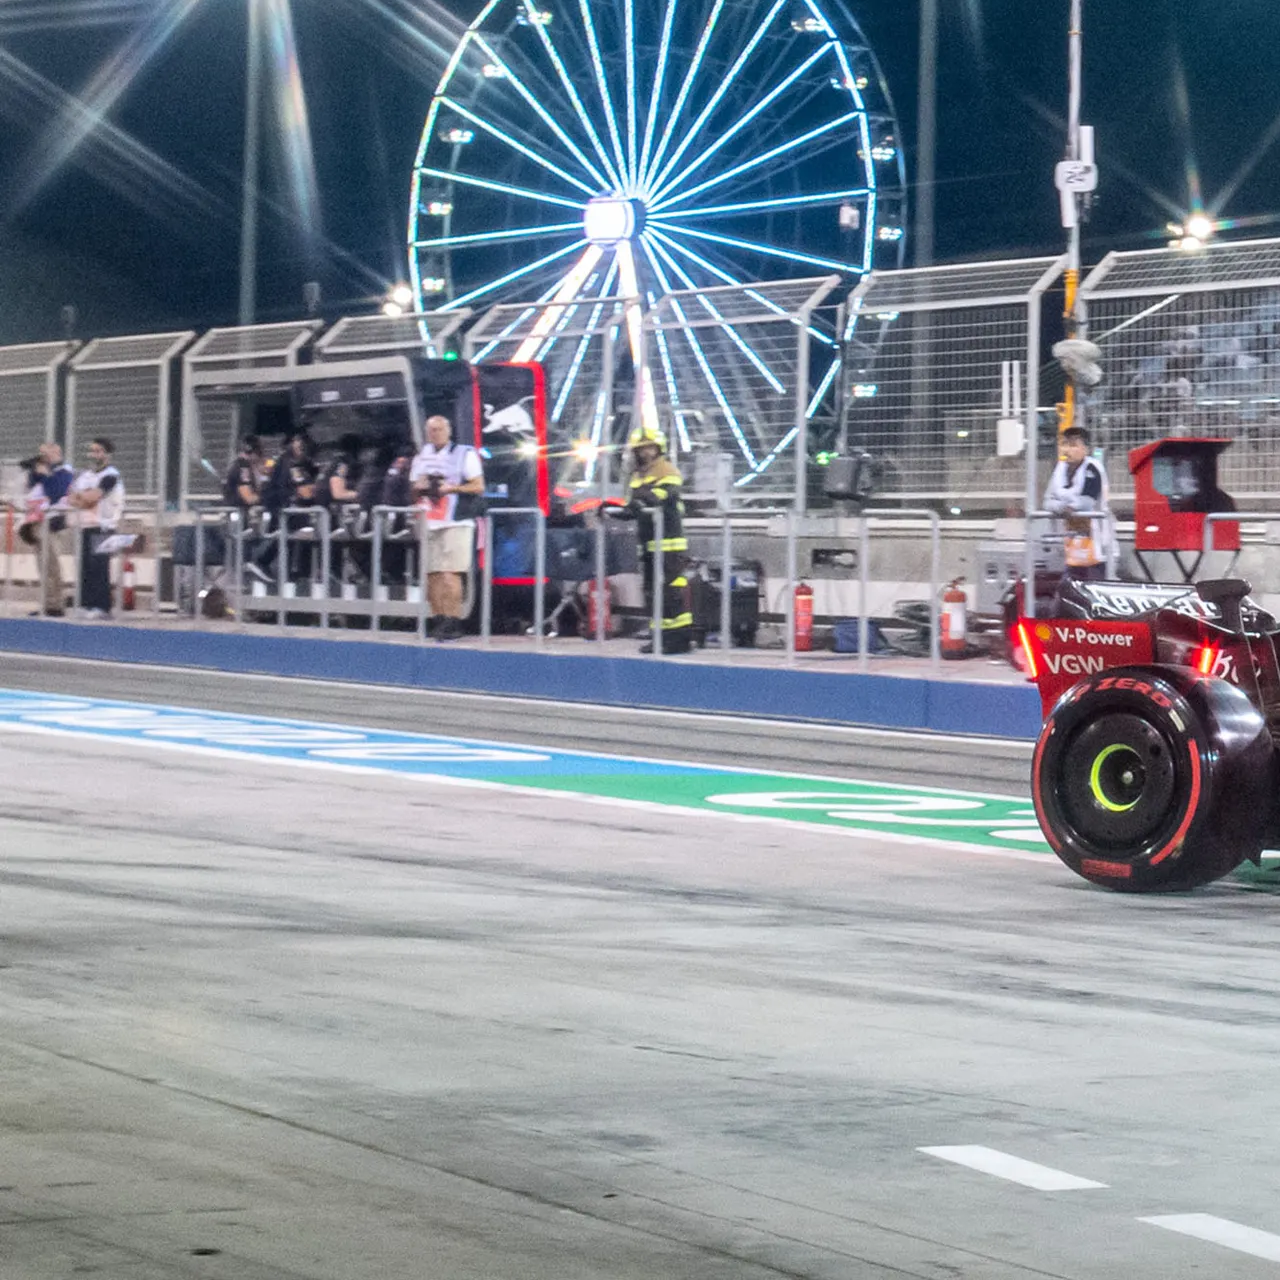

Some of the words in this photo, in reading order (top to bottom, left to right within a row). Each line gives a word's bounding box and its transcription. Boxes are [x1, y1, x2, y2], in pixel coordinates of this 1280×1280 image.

[1055, 627, 1134, 648] V-Power
[1042, 652, 1104, 675] VGW
[1094, 677, 1172, 708] ZERO
